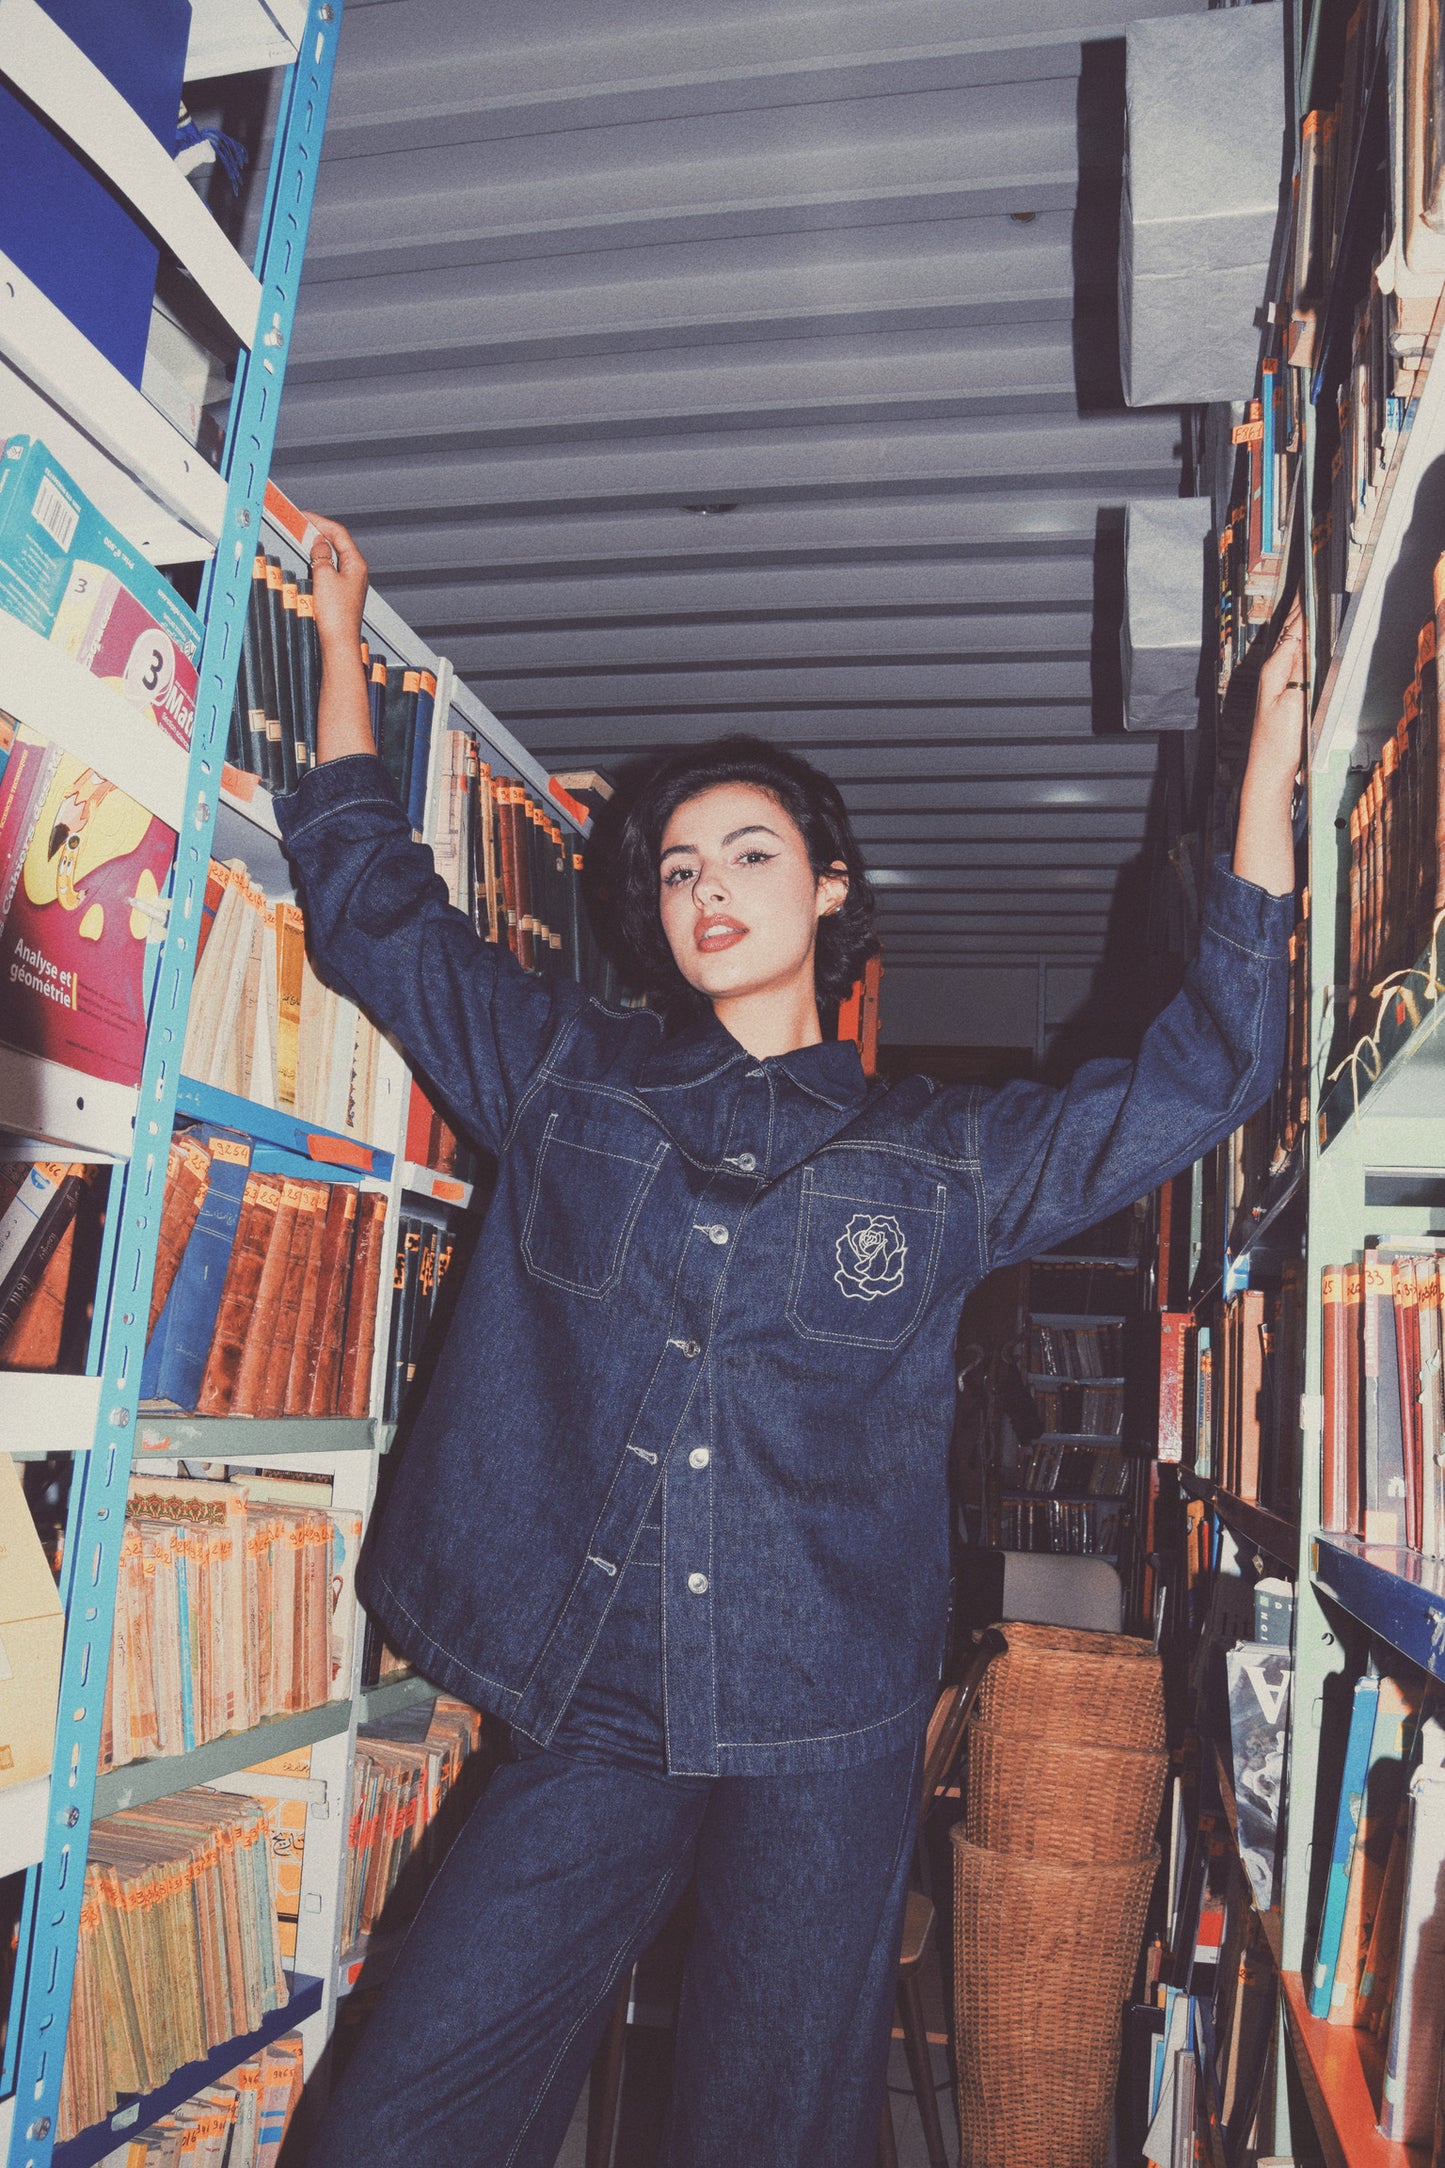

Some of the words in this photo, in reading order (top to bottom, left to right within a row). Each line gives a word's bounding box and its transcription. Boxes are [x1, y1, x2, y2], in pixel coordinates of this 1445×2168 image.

[74, 578, 87, 593] 3
[142, 648, 165, 692] 3
[14, 938, 58, 979] Analyse
[59, 969, 72, 988] et
[9, 962, 72, 1009] géométrie
[216, 1141, 249, 1159] 9254
